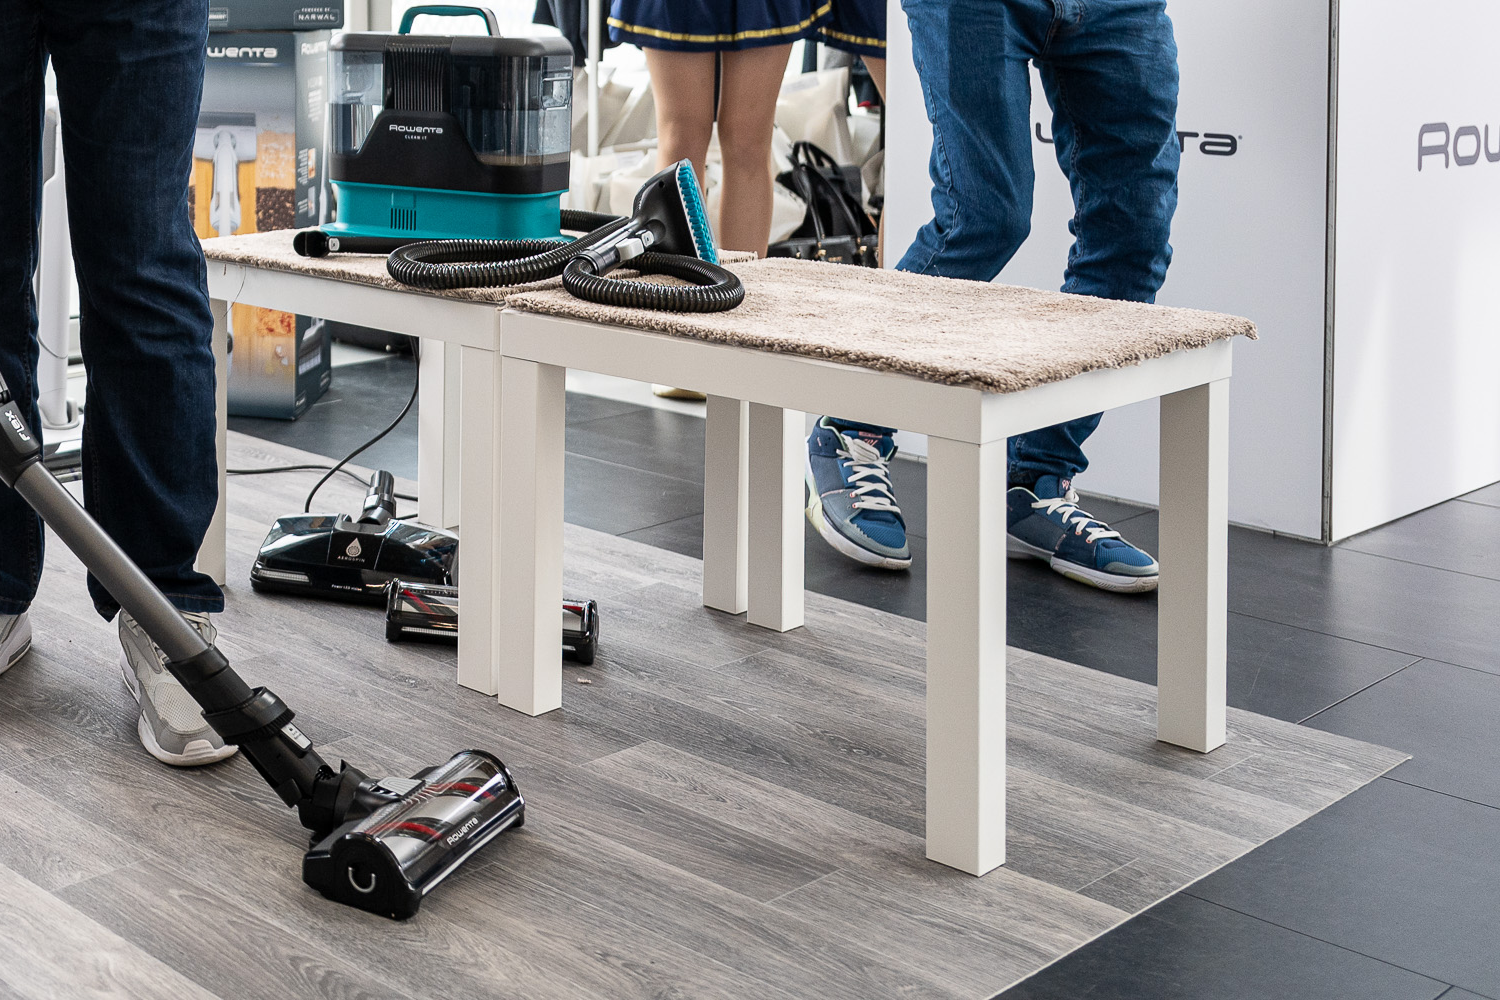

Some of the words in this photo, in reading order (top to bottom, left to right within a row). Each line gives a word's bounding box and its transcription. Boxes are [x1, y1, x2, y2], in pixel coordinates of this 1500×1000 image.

[298, 13, 336, 21] NARWAL
[206, 46, 278, 58] wenta
[389, 124, 444, 134] Rowenta
[446, 817, 479, 846] Rowenta
